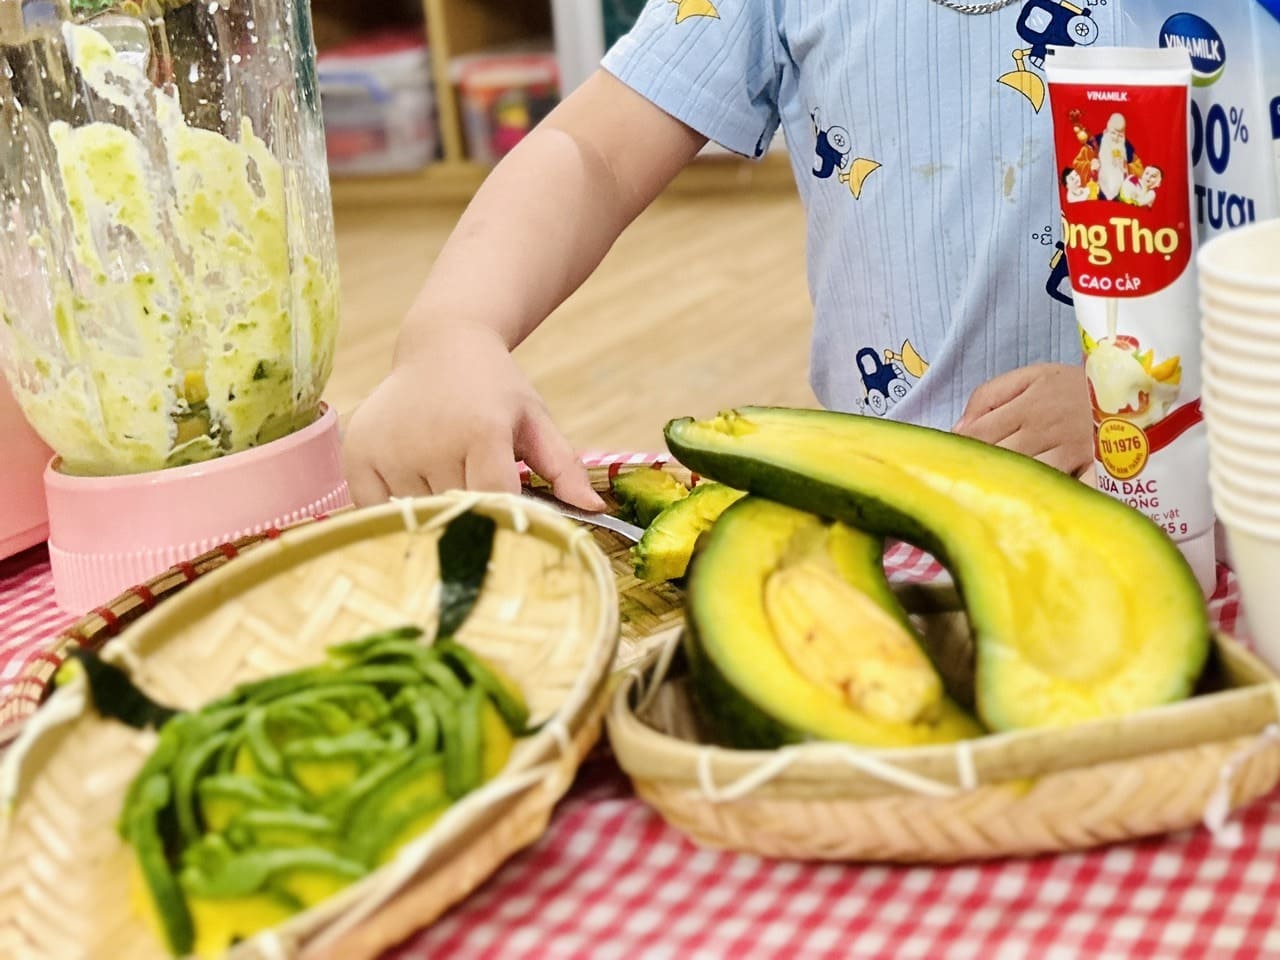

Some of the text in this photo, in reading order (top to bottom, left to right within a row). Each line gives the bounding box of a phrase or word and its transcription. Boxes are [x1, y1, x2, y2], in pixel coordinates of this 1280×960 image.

[1163, 32, 1222, 62] VINAMILK
[1086, 90, 1128, 102] VINAMILK
[1191, 98, 1249, 175] 0%
[1109, 217, 1179, 261] Thọ
[1079, 274, 1112, 291] CAO
[1113, 435, 1142, 453] 1976
[1180, 522, 1188, 535] g
